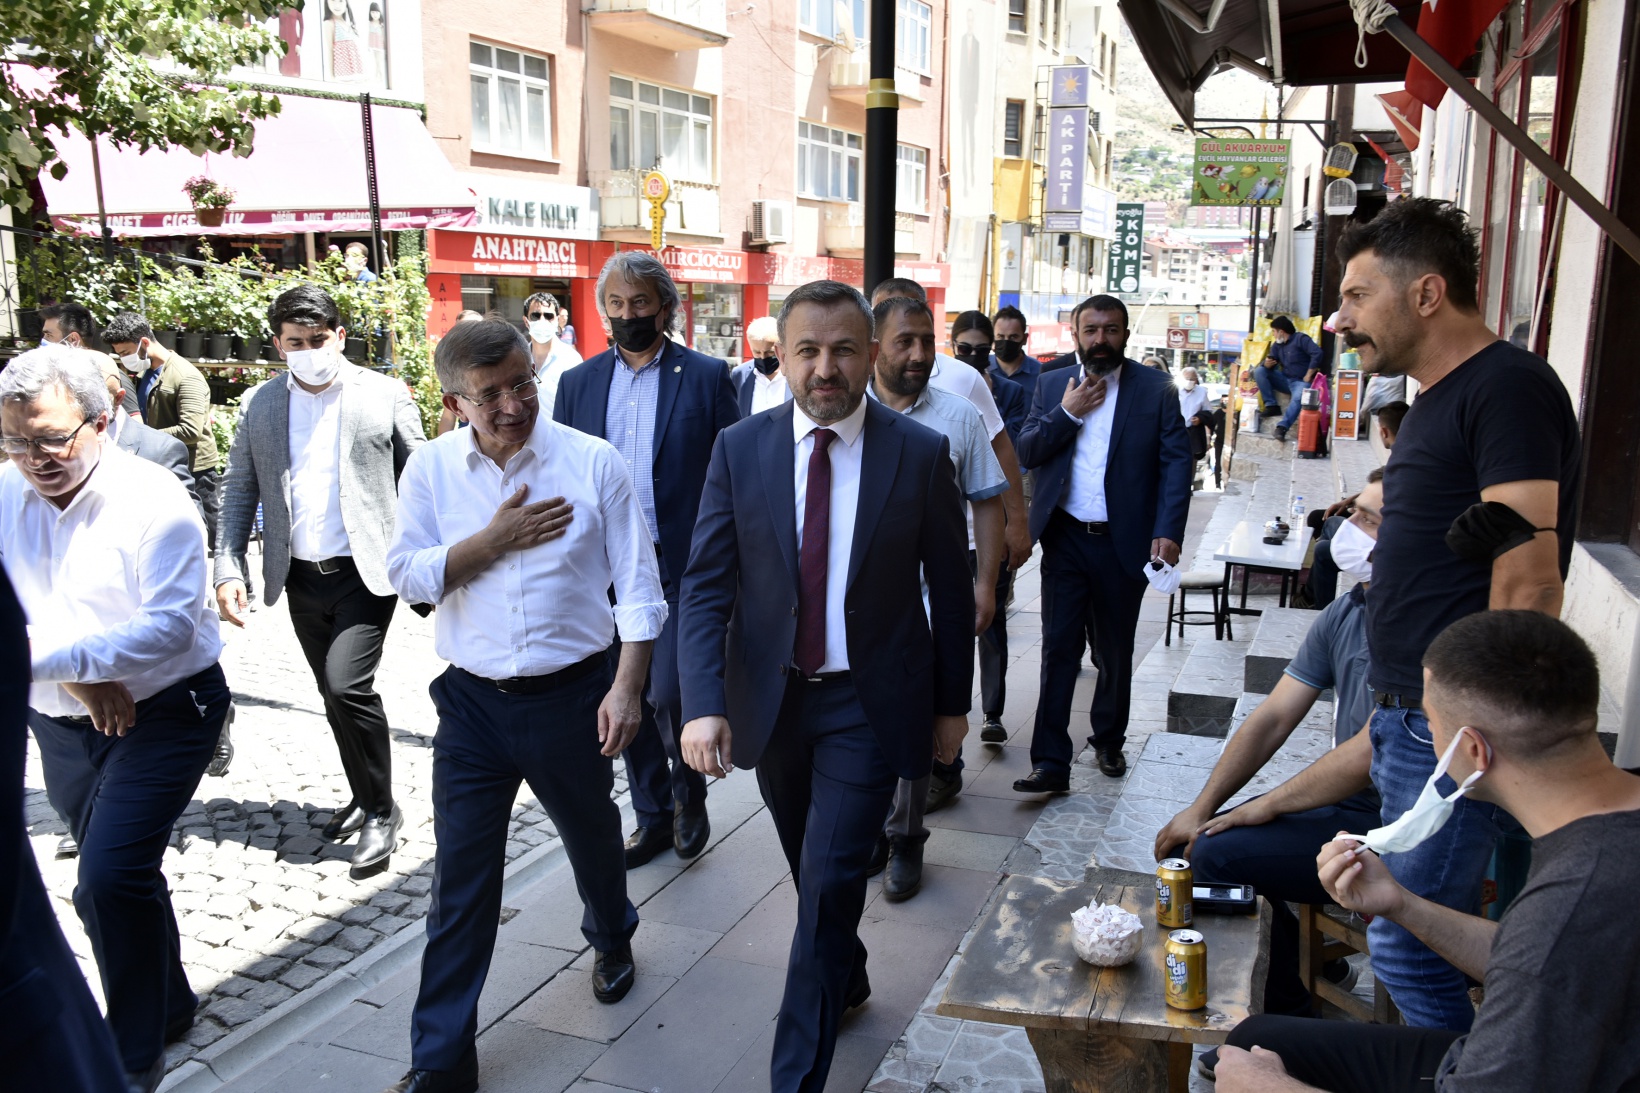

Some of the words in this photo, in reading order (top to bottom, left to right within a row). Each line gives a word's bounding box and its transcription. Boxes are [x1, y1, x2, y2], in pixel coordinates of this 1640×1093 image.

[1061, 114, 1075, 138] AK
[1198, 154, 1216, 162] EVCİL
[1217, 155, 1257, 163] HAYVANLAR
[1258, 155, 1287, 163] GALERİSİ
[1201, 141, 1222, 153] GÜL
[1224, 143, 1287, 153] AKVARYUM
[1059, 144, 1074, 205] PARTİ
[488, 197, 536, 219] KALE
[1116, 208, 1142, 217] eyoğlu
[471, 235, 577, 263] ANAHTARCI
[1109, 219, 1123, 291] PESTİL
[1123, 219, 1139, 276] KÖME
[1159, 884, 1170, 897] di
[1166, 953, 1176, 967] di
[1172, 961, 1186, 976] di
